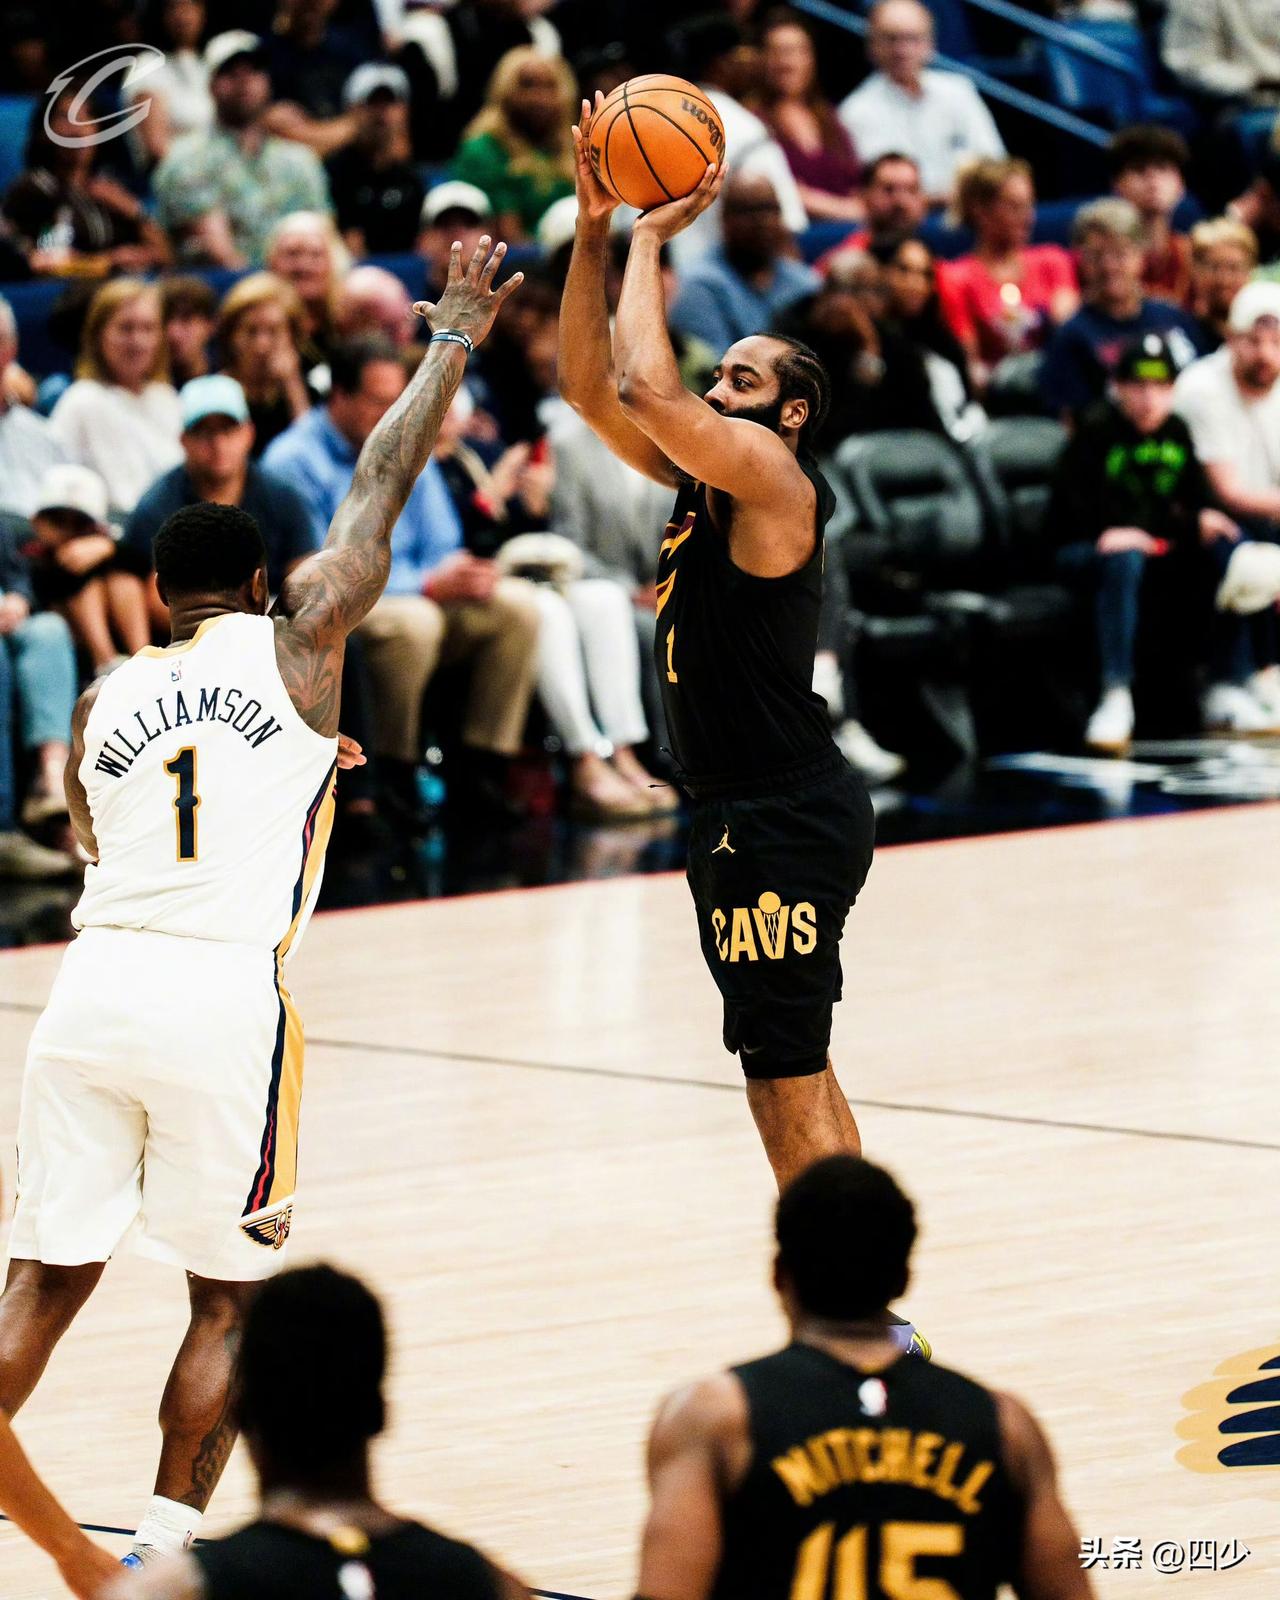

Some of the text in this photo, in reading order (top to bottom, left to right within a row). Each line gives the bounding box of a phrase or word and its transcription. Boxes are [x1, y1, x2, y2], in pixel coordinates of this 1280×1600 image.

[666, 624, 678, 683] 1
[94, 687, 283, 778] WILLIAMSON
[163, 745, 202, 862] 1
[711, 892, 817, 962] CAVS
[771, 1426, 995, 1515] MITCHELL
